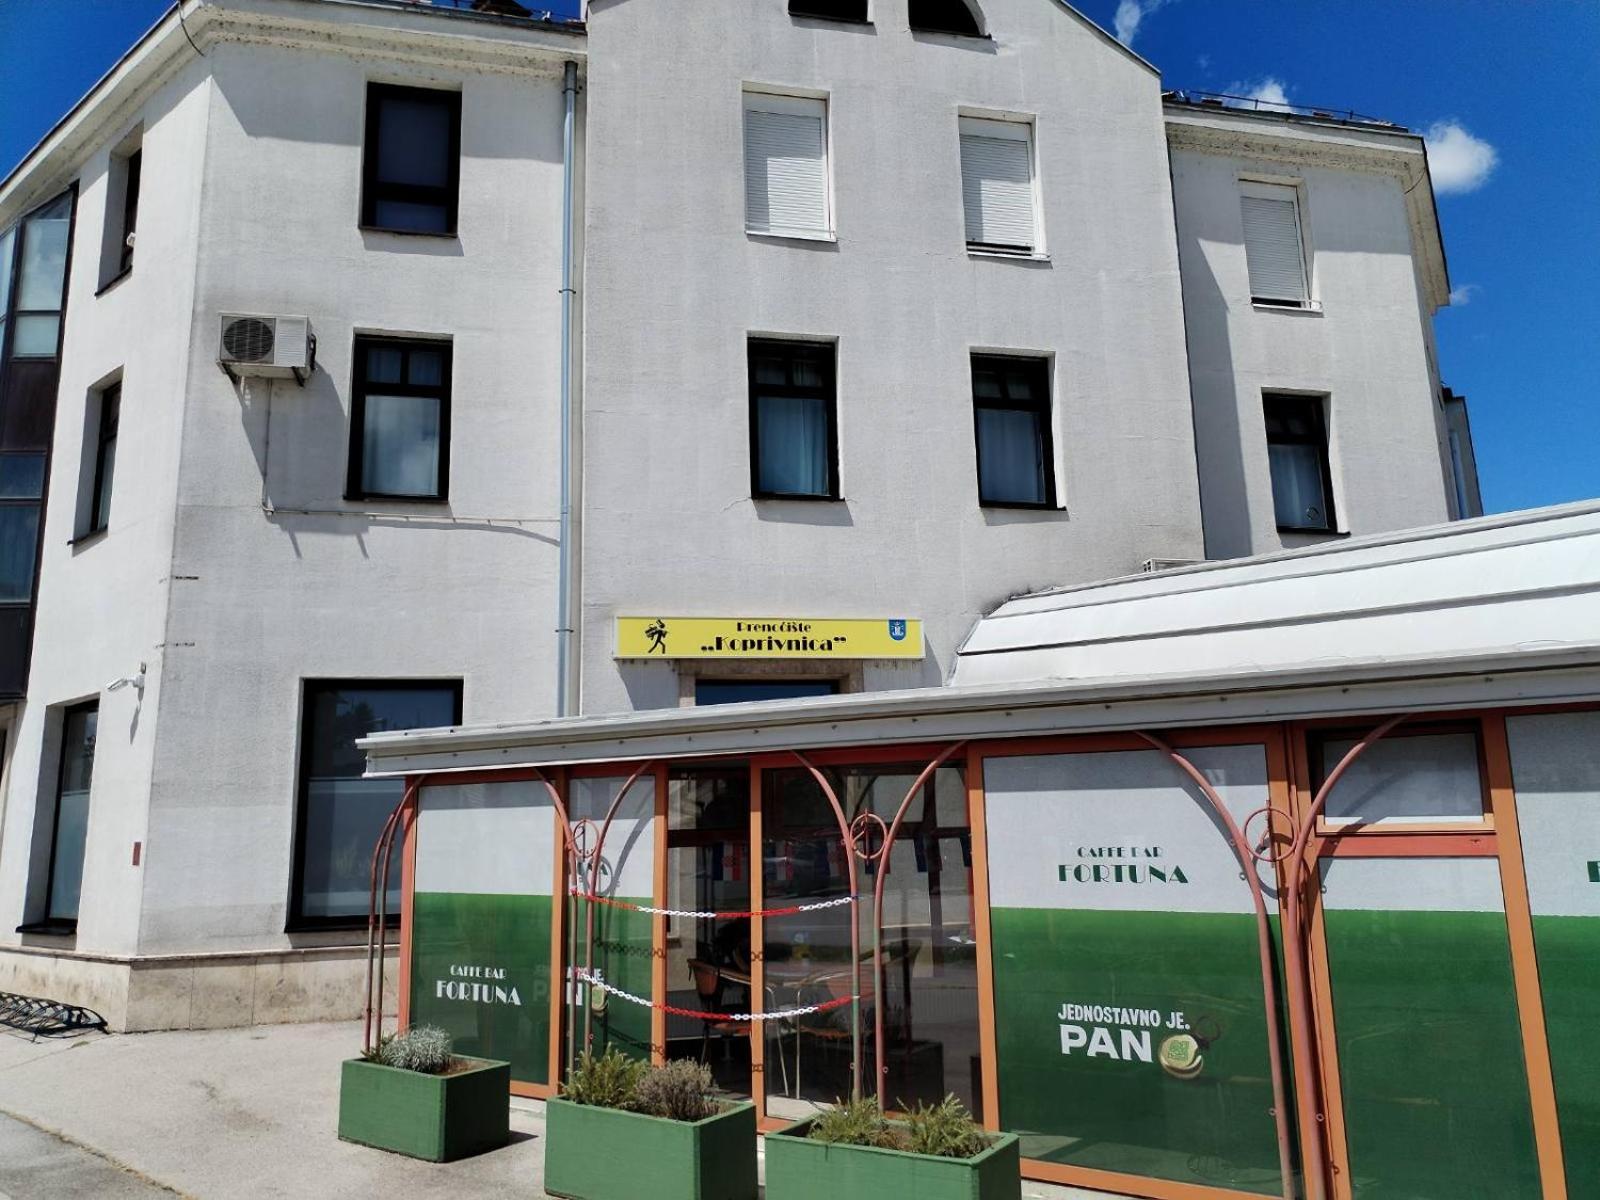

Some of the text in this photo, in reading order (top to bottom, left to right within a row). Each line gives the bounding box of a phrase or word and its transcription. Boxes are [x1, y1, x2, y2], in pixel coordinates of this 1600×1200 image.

[1077, 846, 1163, 858] CAFFE BAR
[1058, 863, 1188, 884] FORTUNA
[450, 964, 507, 980] CAFFE BAR
[436, 980, 521, 1006] FORTUNA
[1058, 1003, 1191, 1030] JEDNOSTAVNO JE.
[1060, 1024, 1153, 1063] PAN
